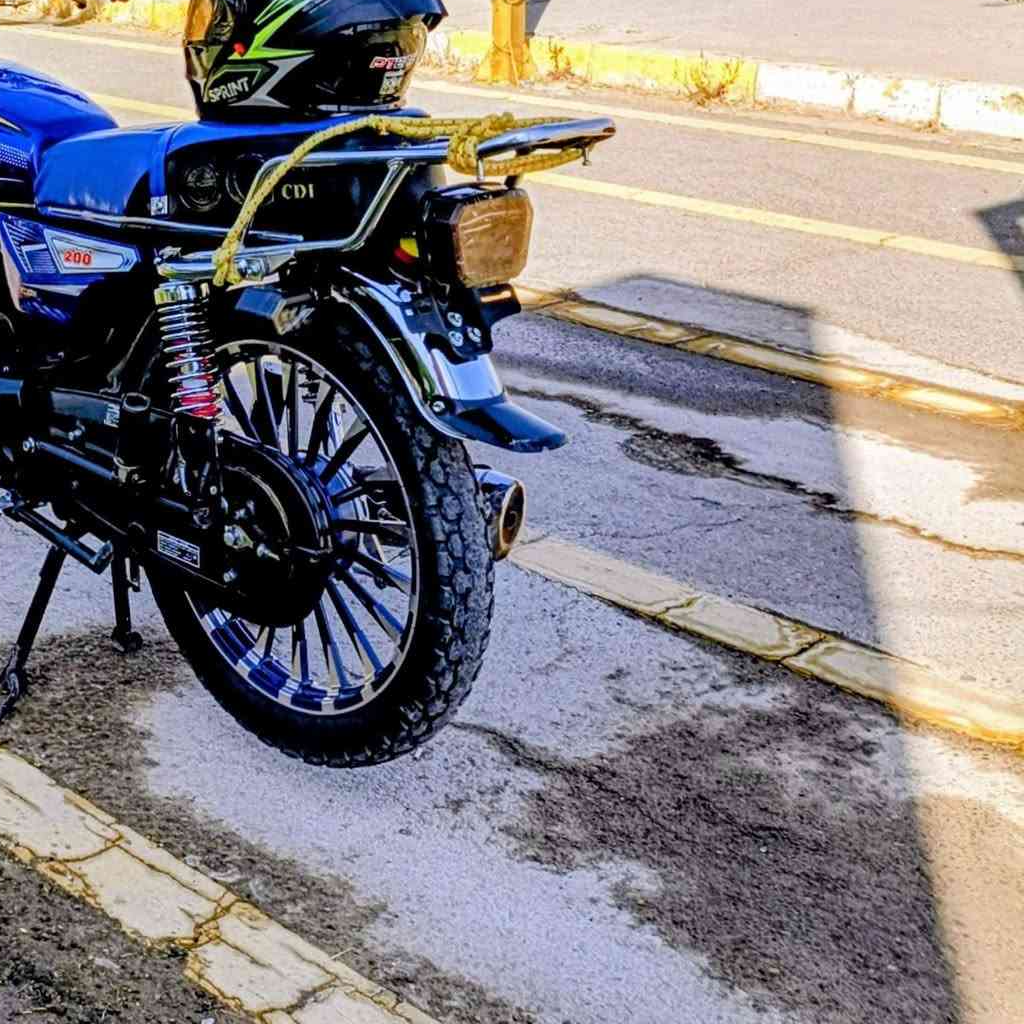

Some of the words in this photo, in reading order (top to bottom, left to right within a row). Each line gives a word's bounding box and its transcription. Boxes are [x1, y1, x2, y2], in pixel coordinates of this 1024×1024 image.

[208, 77, 249, 103] SPRINT
[281, 183, 314, 200] CDI
[63, 249, 93, 266] 200
